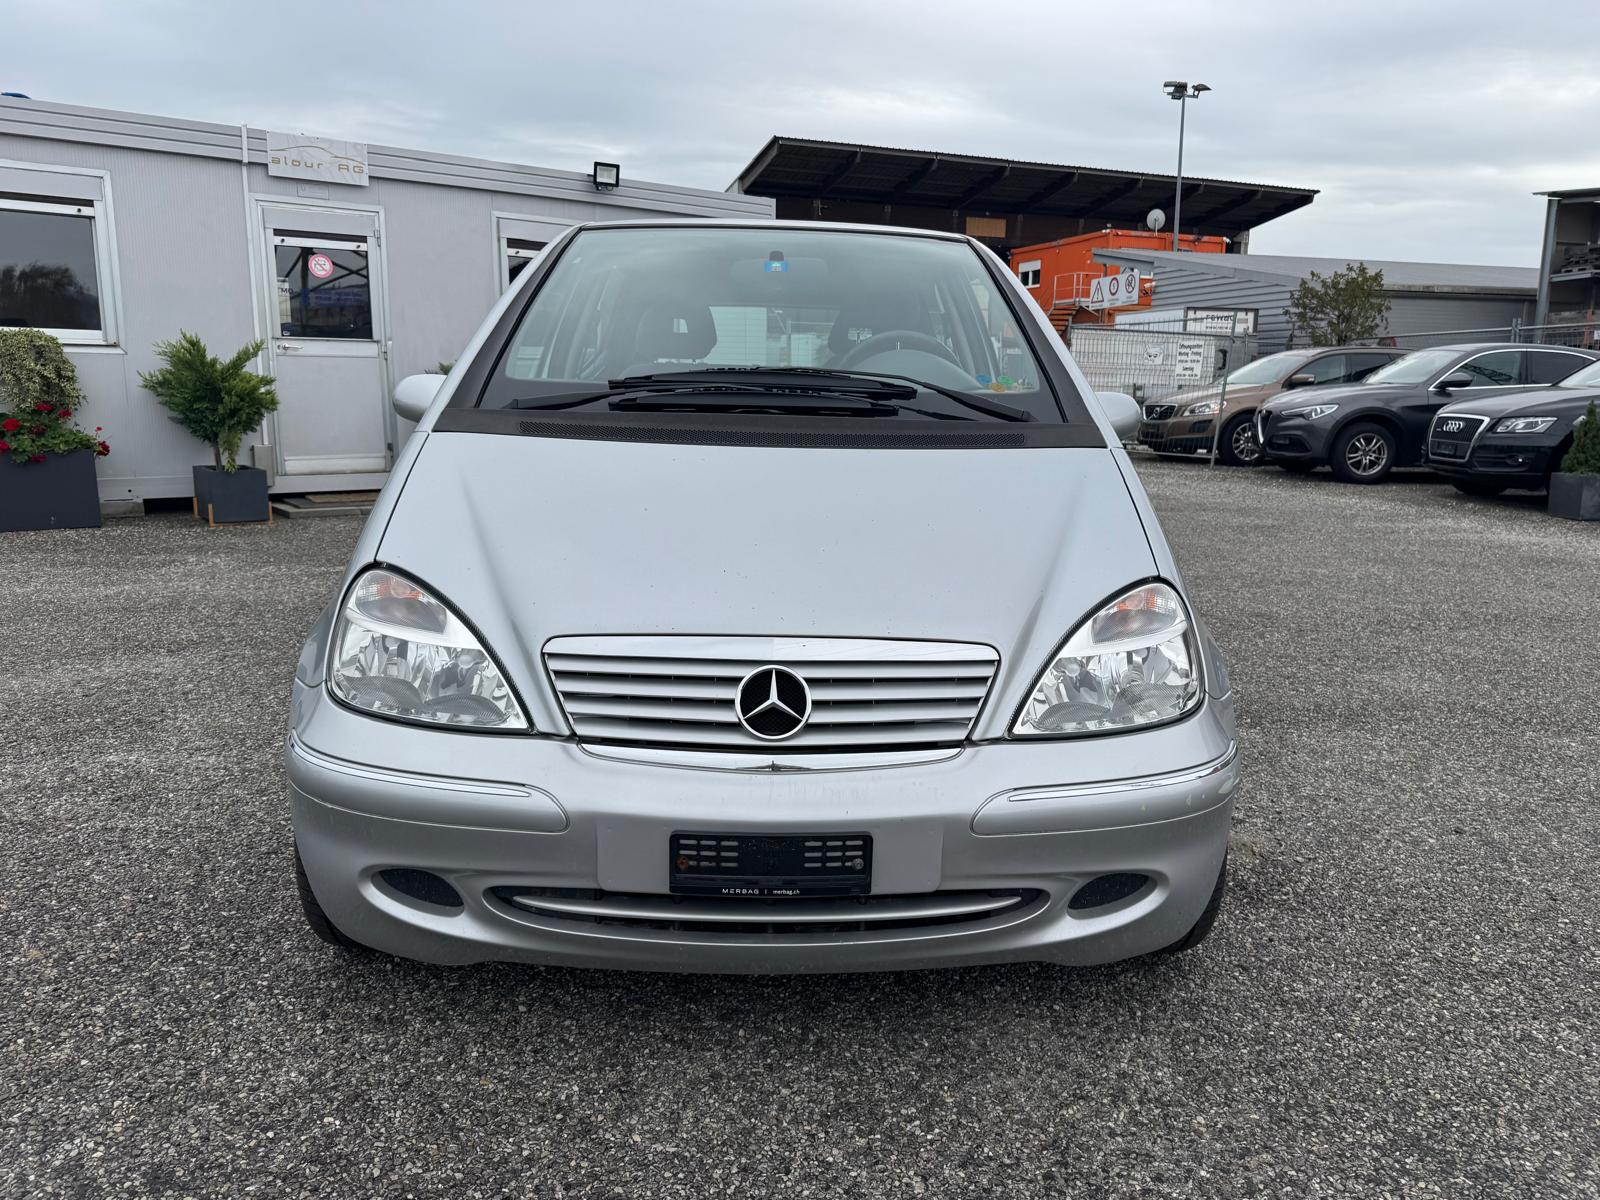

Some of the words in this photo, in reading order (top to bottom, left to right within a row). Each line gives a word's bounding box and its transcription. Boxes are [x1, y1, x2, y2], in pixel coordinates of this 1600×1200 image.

[271, 156, 323, 169] alour
[338, 163, 364, 174] AG
[773, 888, 800, 896] merbag.ch
